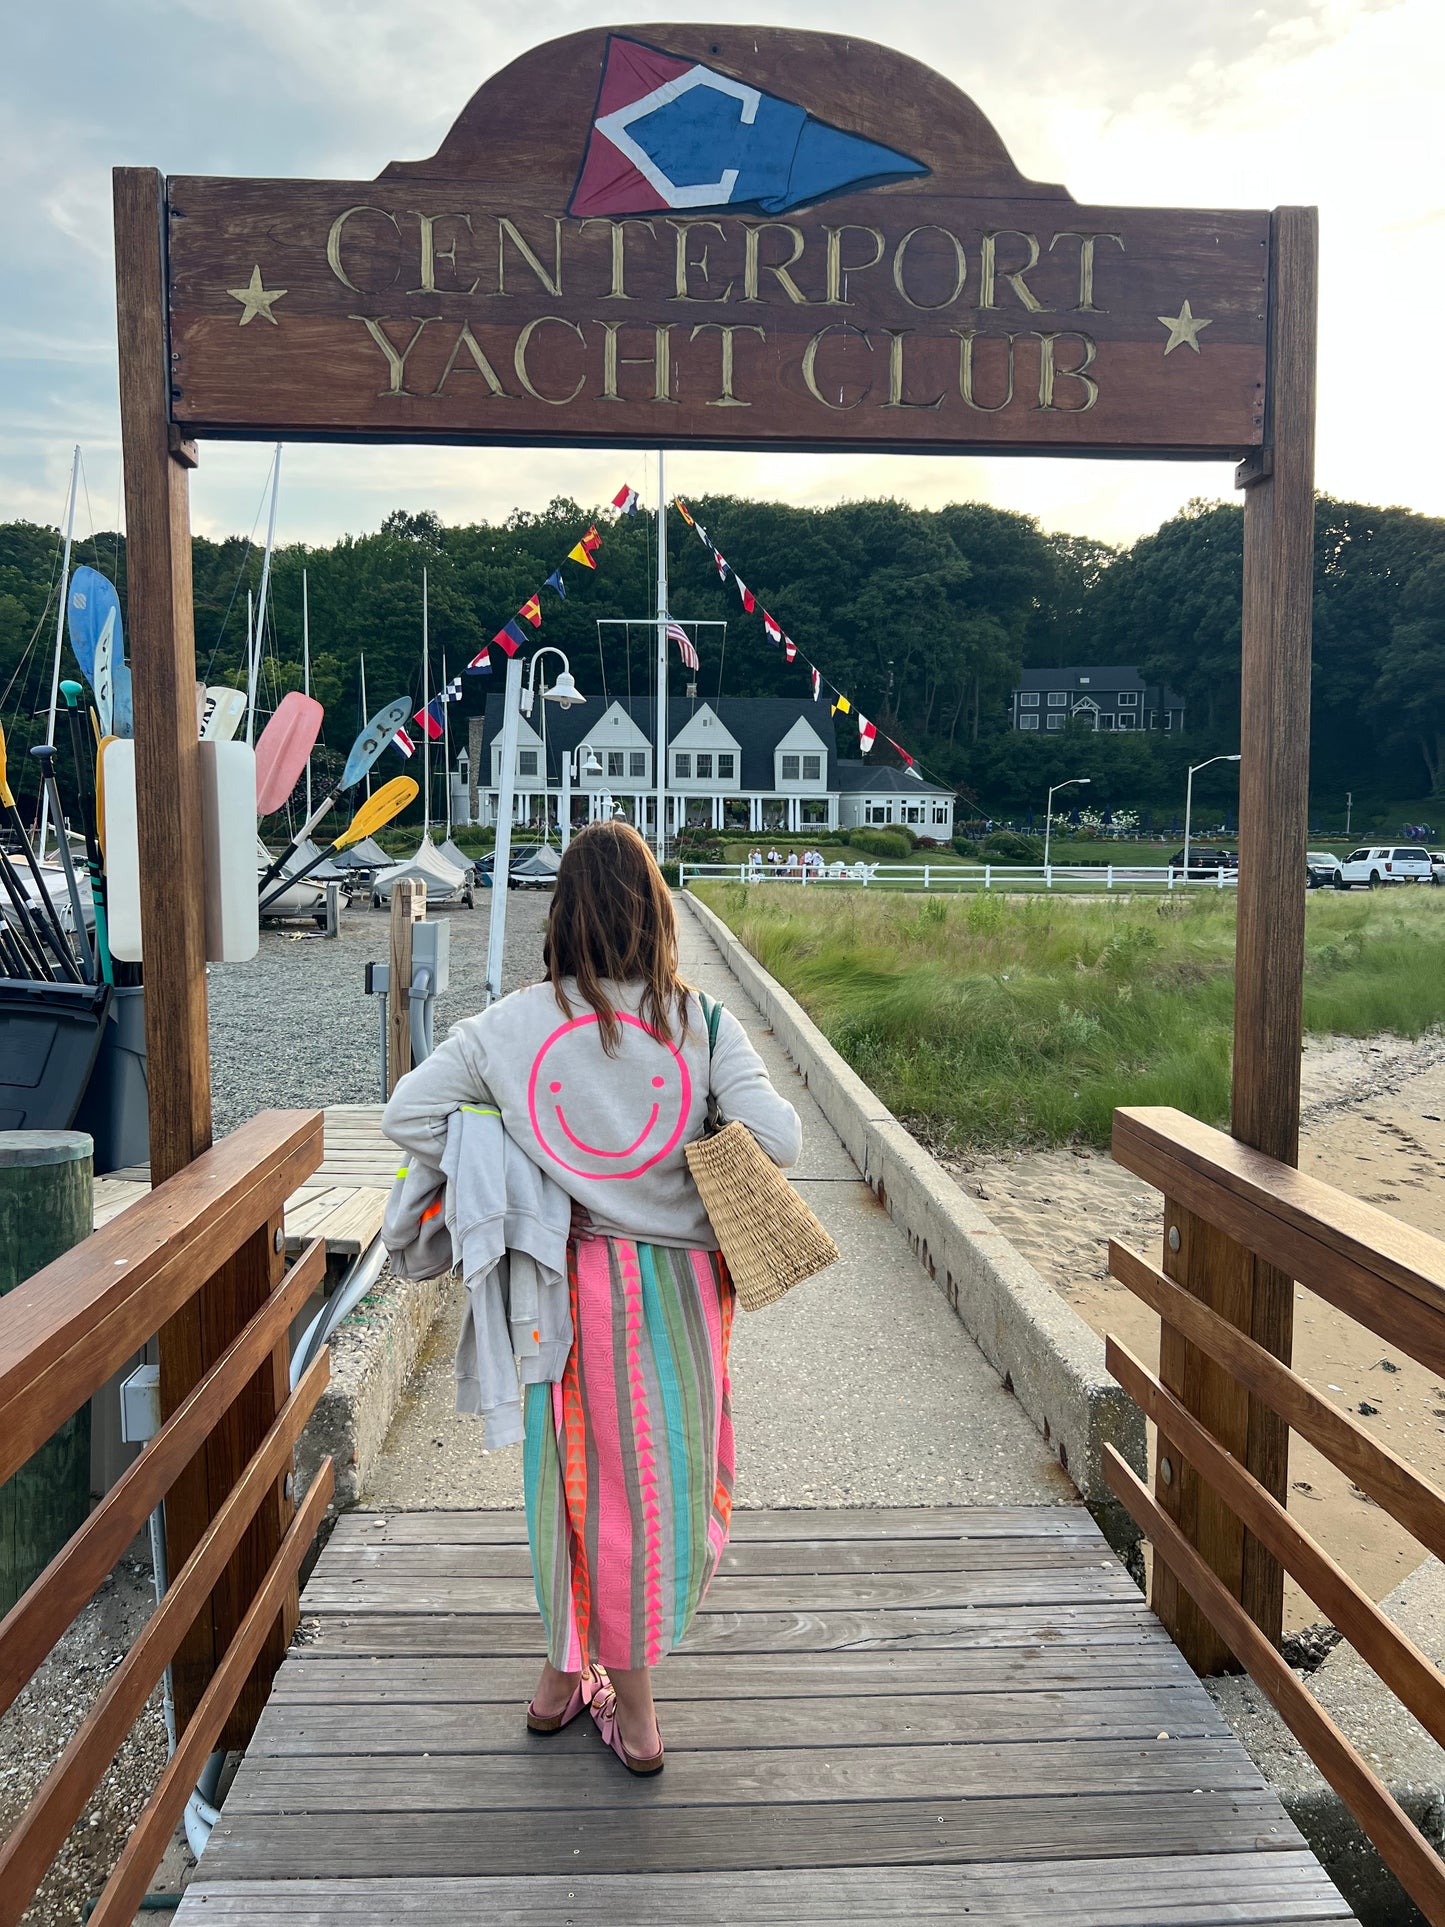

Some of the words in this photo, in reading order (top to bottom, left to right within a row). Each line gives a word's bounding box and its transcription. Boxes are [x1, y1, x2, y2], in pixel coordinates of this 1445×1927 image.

[326, 206, 1125, 313] CENTERPORT
[347, 315, 767, 406] YACHT
[801, 322, 1099, 412] CLUB
